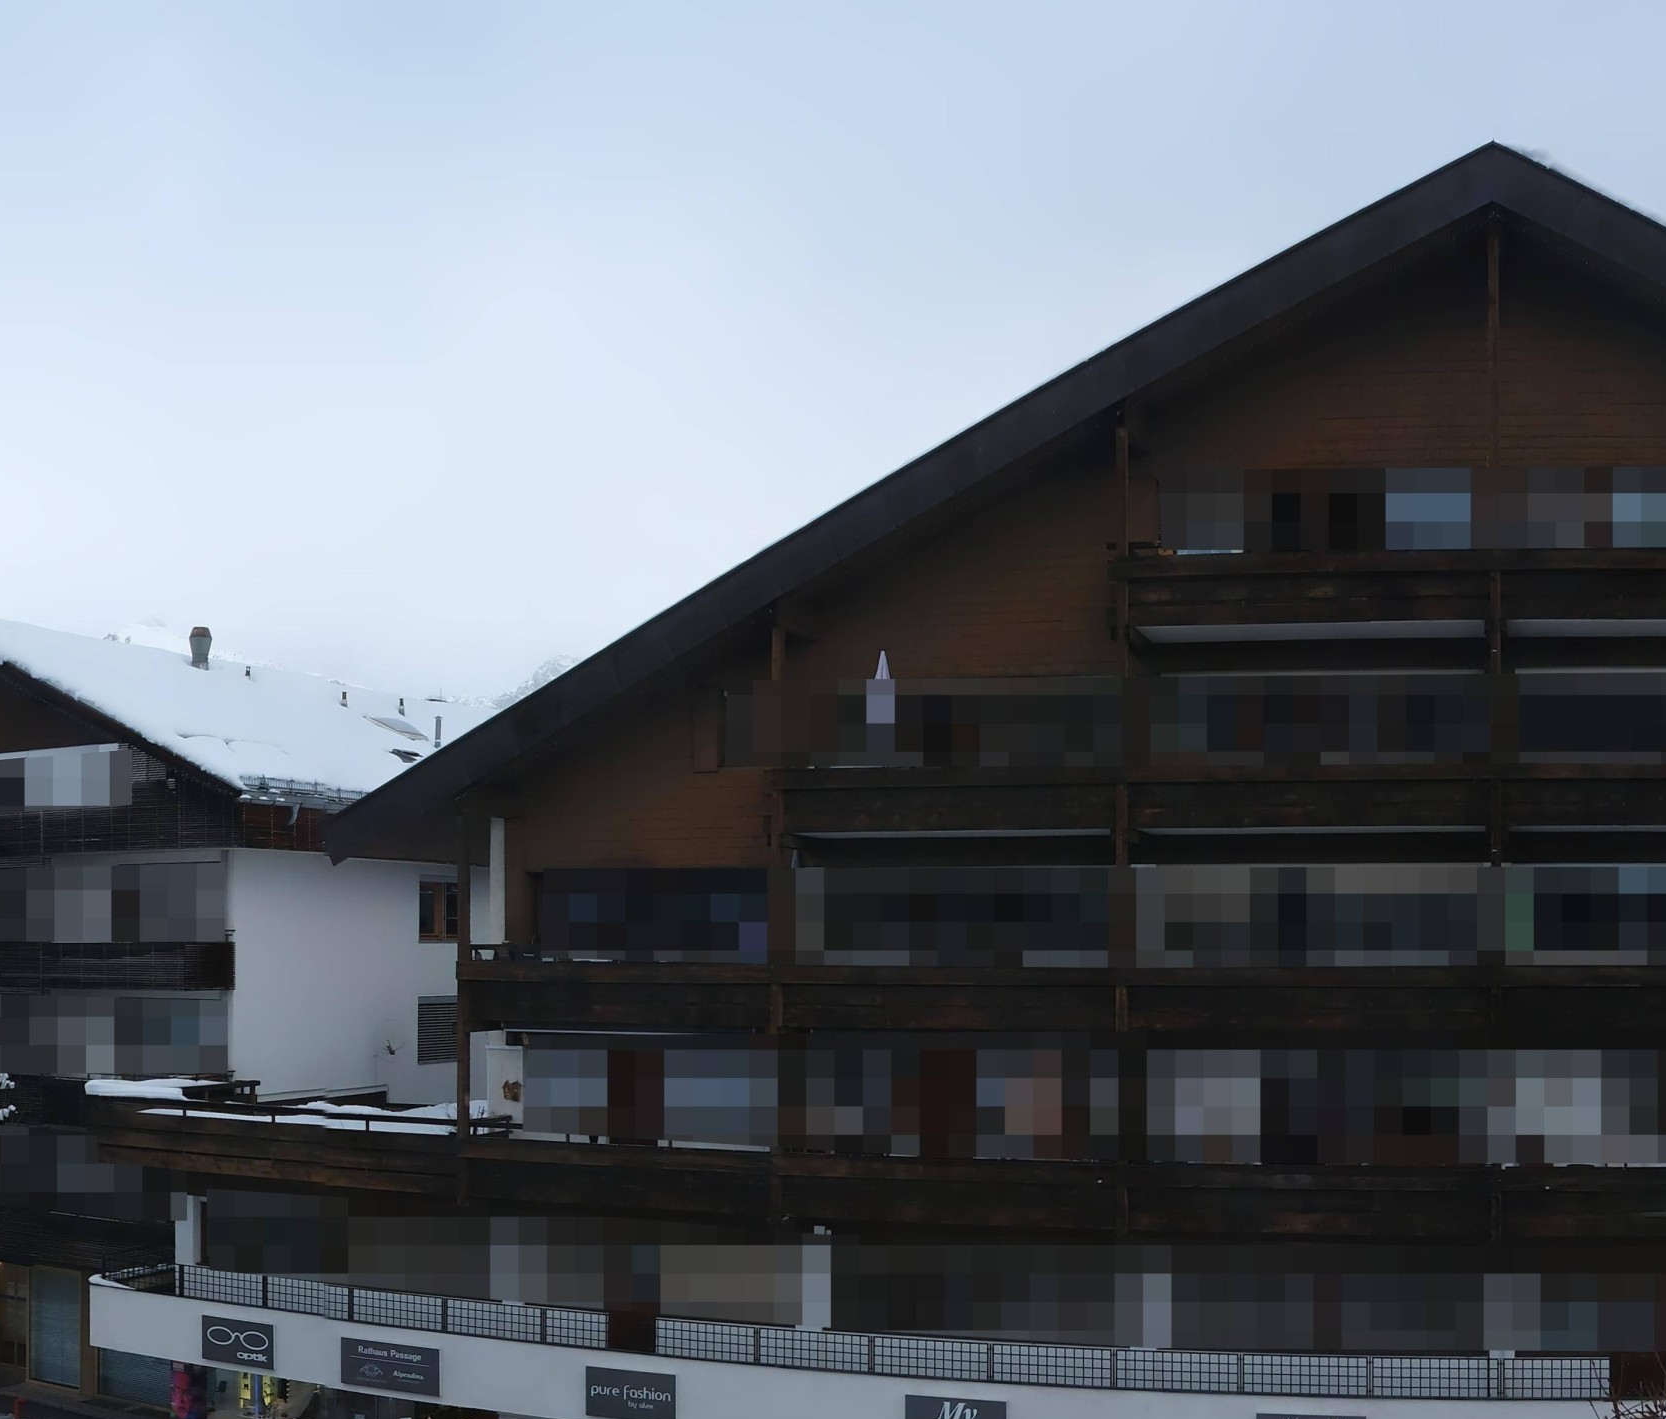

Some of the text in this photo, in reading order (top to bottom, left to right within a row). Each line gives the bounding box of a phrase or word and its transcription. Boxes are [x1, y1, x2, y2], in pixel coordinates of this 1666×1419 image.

[237, 1351, 268, 1363] optik
[358, 1345, 422, 1362] Rathaus Passage
[590, 1385, 671, 1402] pure fashion
